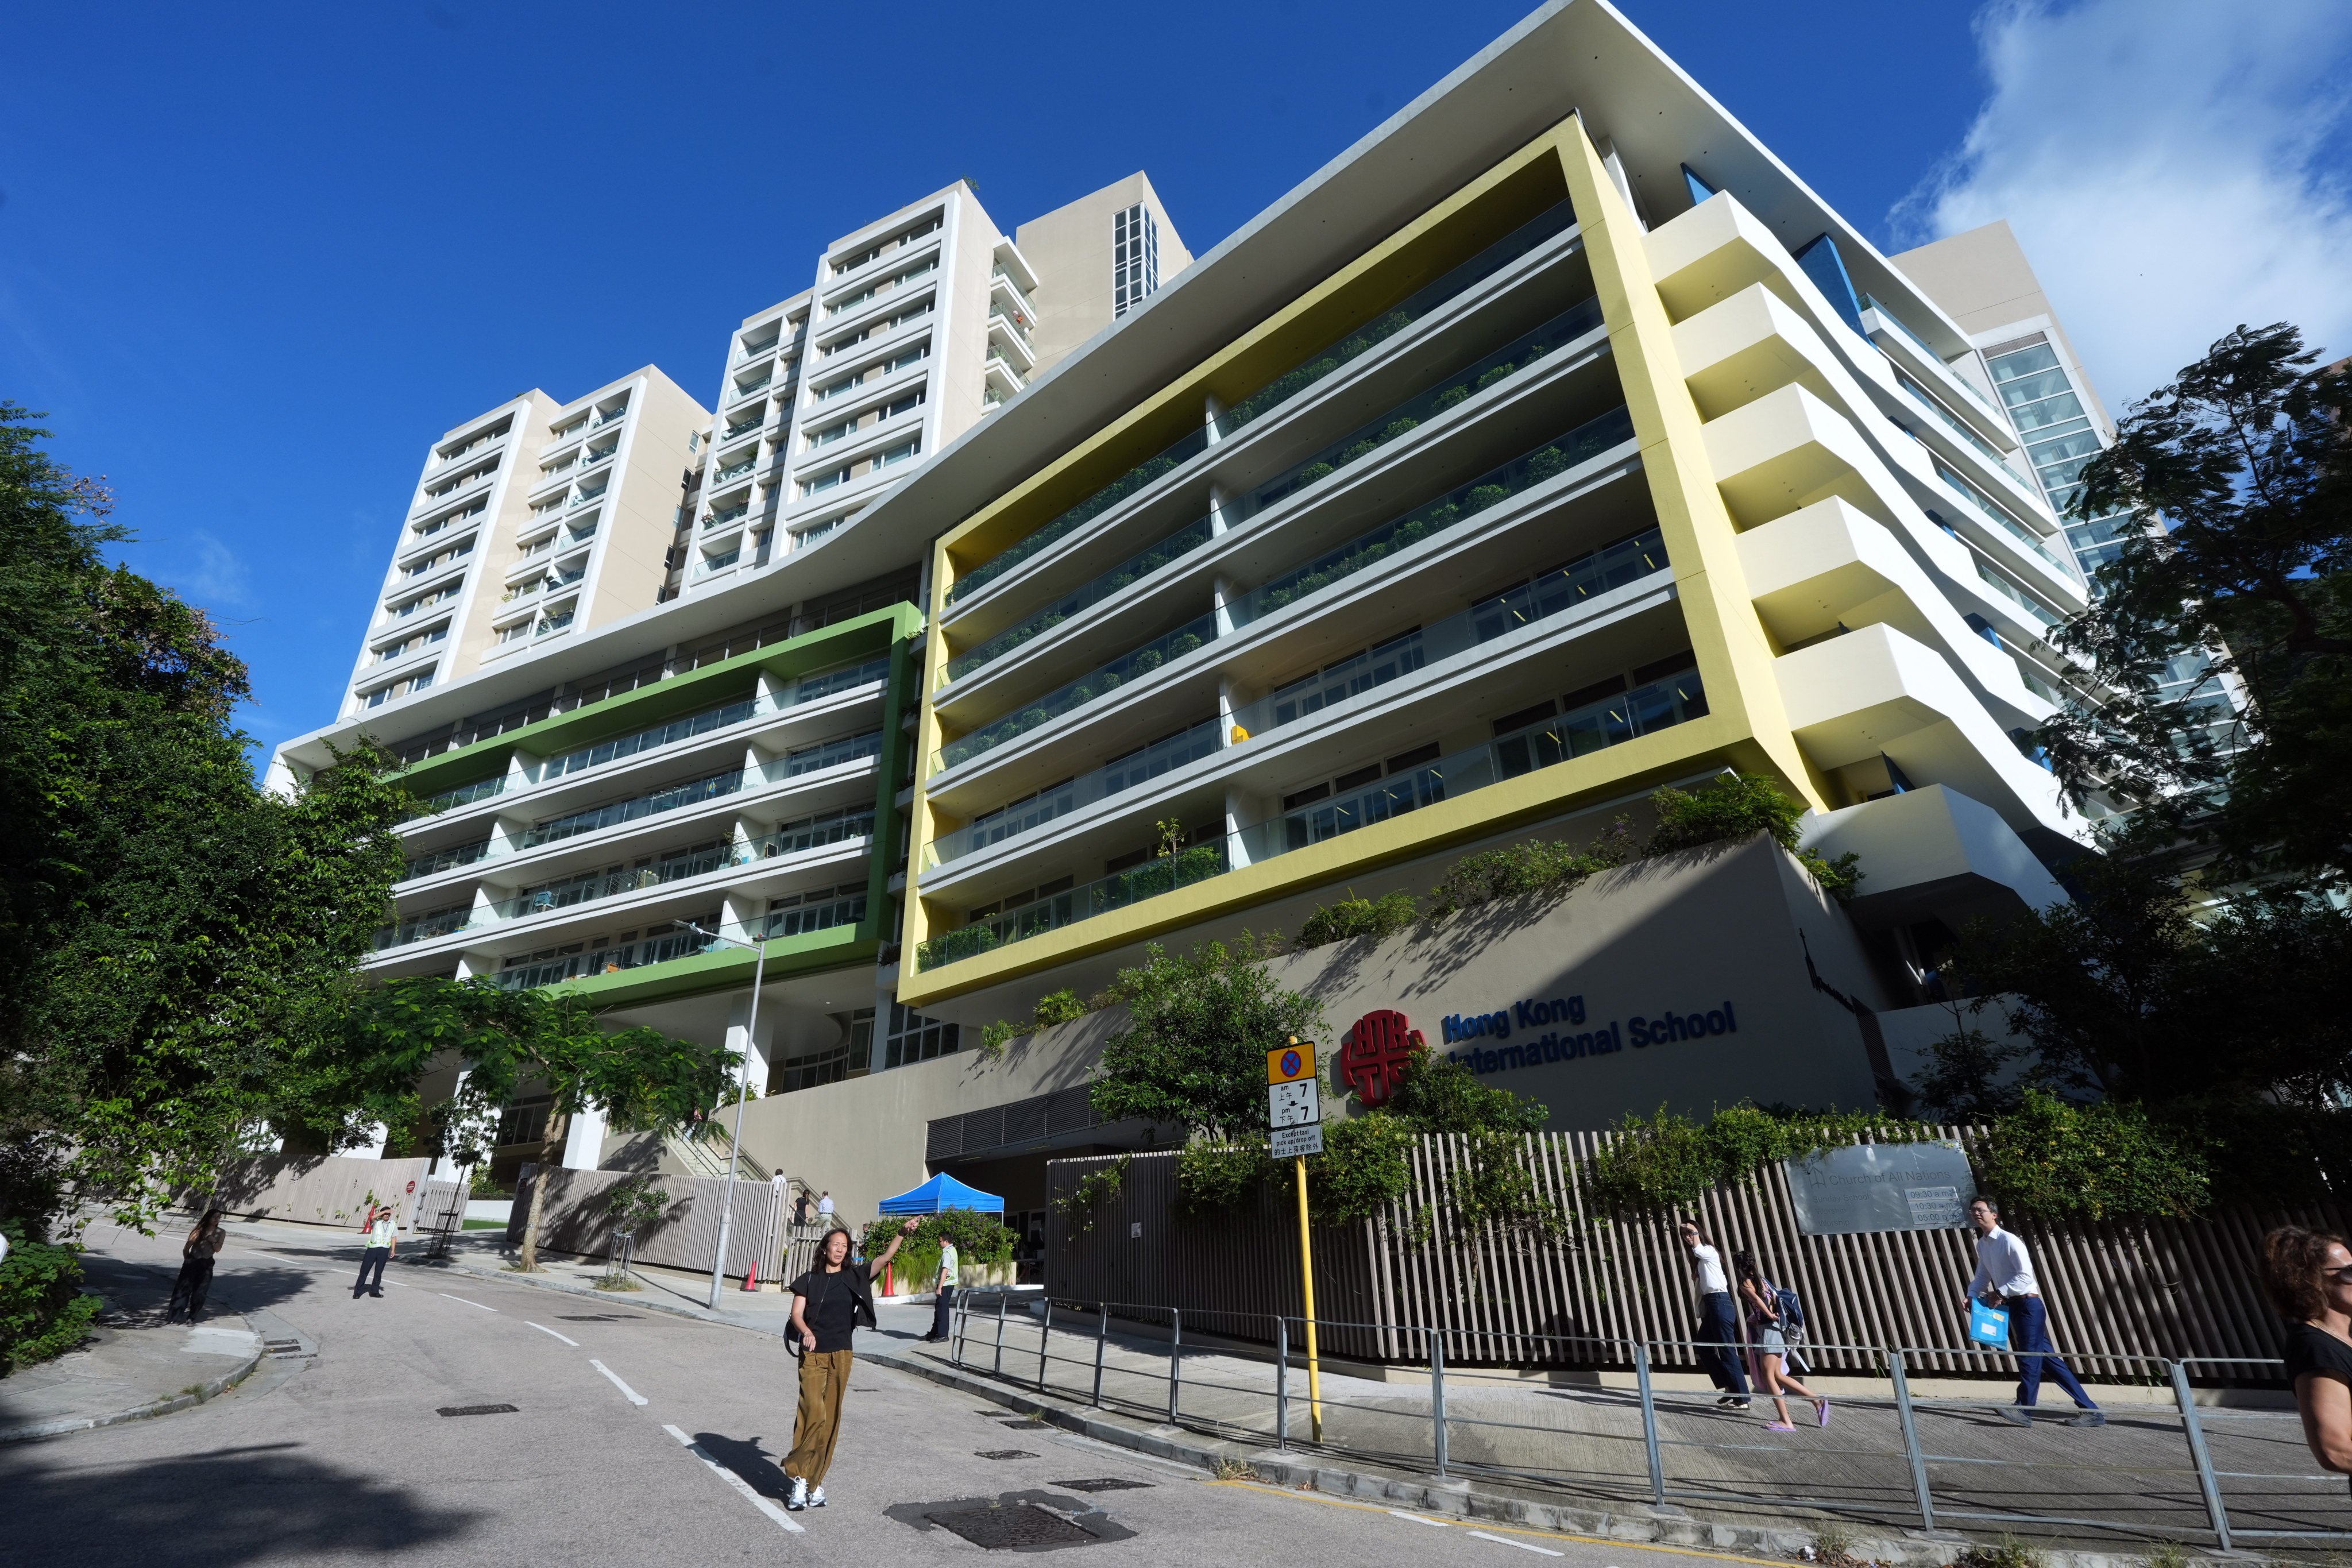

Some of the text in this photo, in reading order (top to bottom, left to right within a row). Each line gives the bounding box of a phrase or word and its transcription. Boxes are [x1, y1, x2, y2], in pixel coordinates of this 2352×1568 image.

[1444, 995, 1586, 1044] Hong Kong
[1628, 1001, 1737, 1048] School
[1299, 1083, 1307, 1098] 7
[1279, 1092, 1292, 1101] 上午
[1300, 1106, 1309, 1121] 7
[1279, 1115, 1293, 1124] 下午
[1281, 1130, 1299, 1138] Except
[1287, 1137, 1307, 1145] up/drop
[1274, 1142, 1319, 1156] 的士上落客除外
[1829, 1171, 1952, 1185] Church of All Nations
[1813, 1193, 1870, 1203] Sunday School
[1910, 1191, 1932, 1199] 09:30
[1918, 1213, 1940, 1221] 05:00
